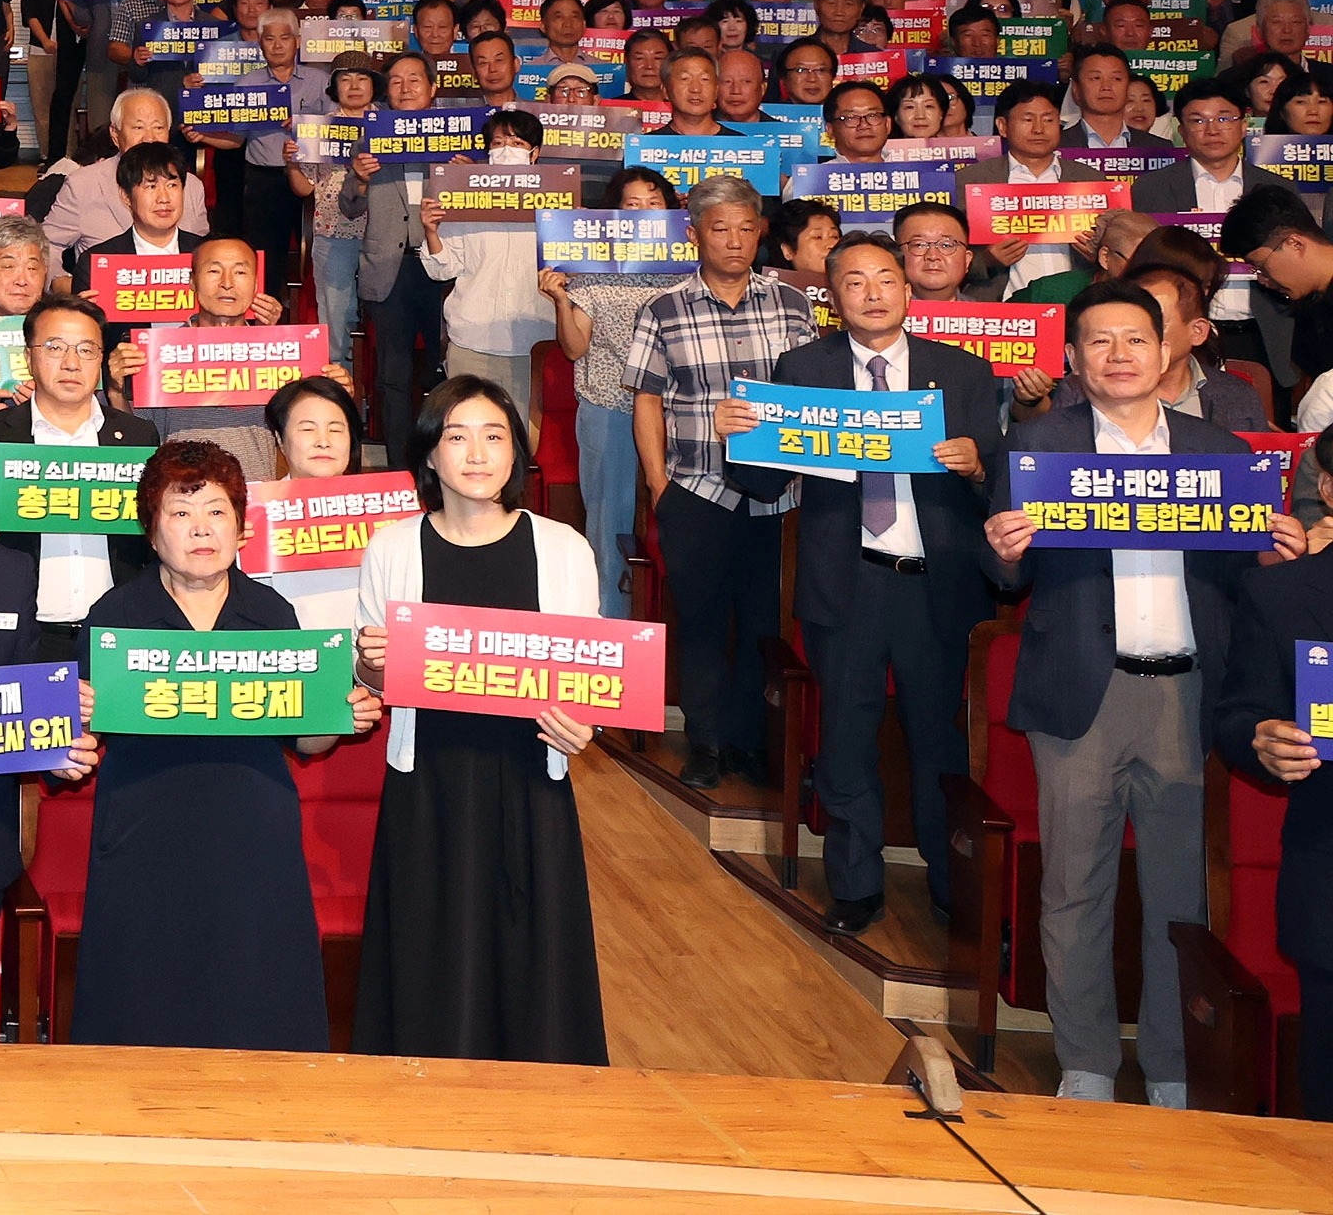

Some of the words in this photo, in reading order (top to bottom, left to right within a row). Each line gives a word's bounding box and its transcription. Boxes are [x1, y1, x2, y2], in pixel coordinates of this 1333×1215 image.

[328, 27, 352, 37] 2027
[355, 27, 373, 37] 태안
[203, 92, 242, 109] 충남·태안
[245, 91, 267, 106] 함께
[183, 108, 230, 125] 발전공기업
[232, 106, 268, 123] 통합본사
[270, 105, 289, 121] 유치
[394, 114, 441, 136] 충남·태안
[445, 115, 472, 133] 함께
[369, 137, 425, 157] 발전공기업
[428, 134, 471, 154] 통합본사
[640, 147, 704, 166] 태안~서산
[710, 147, 765, 166] 고속도로
[468, 174, 510, 189] 2027
[513, 174, 541, 189] 태안
[437, 189, 520, 212] 유류피해극복
[522, 188, 574, 210] 20주년
[990, 195, 1017, 212] 충남
[1020, 194, 1108, 212] 미래항공산업
[573, 218, 633, 241] 충남·태안
[638, 219, 668, 240] 함께
[990, 215, 1066, 235] 중심도시
[542, 241, 611, 263] 발전공기업
[613, 240, 668, 263] 통합본사
[159, 342, 195, 363] 충남
[199, 340, 301, 363] 미래항공산업
[161, 367, 252, 394] 중심도시
[843, 409, 922, 430] 고속도로
[778, 427, 830, 456] 조기
[836, 432, 892, 460] 착공
[1070, 467, 1169, 497] 충남·태안
[1175, 468, 1221, 498] 함께
[1022, 501, 1130, 531] 발전공기업
[1136, 503, 1223, 532] 통합본사
[1229, 503, 1271, 533] 유치
[425, 625, 473, 654] 충남
[478, 630, 623, 668] 미래항공산업
[127, 649, 170, 672] 태안
[175, 649, 318, 674] 소나무재선충병
[423, 659, 549, 701] 중심도시
[558, 671, 623, 709] 태안
[144, 678, 218, 719] 총력
[230, 679, 303, 720] 방제
[29, 716, 72, 751] 유치
